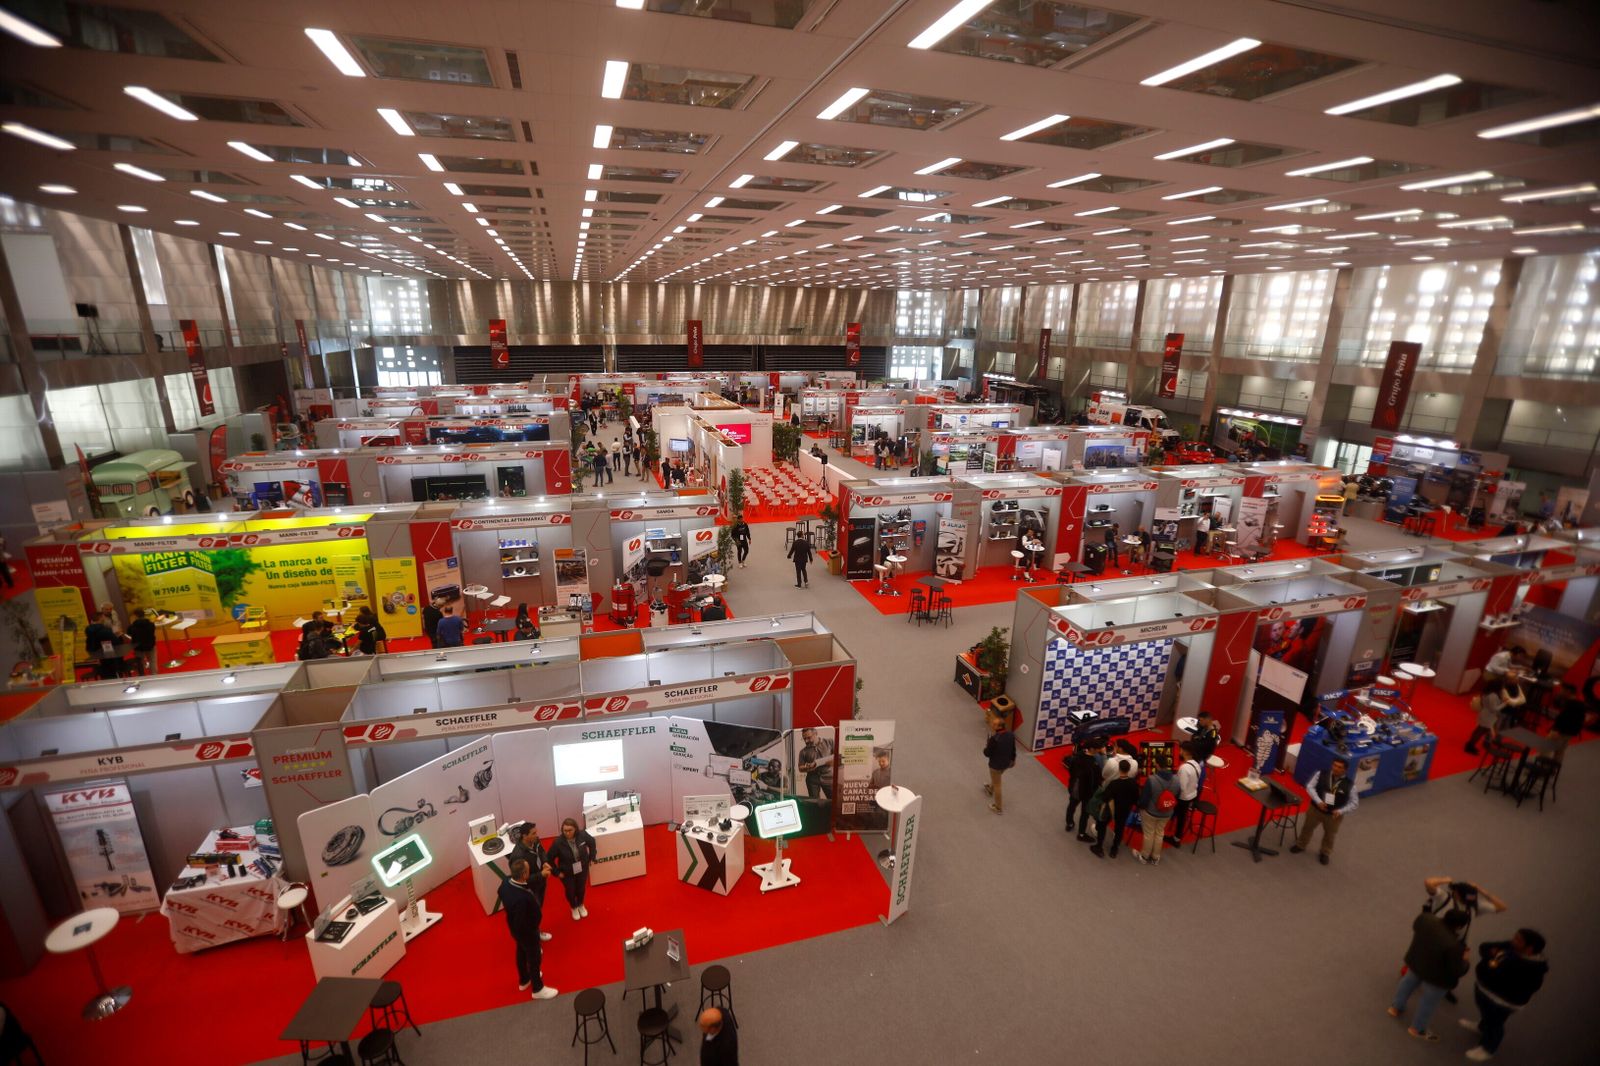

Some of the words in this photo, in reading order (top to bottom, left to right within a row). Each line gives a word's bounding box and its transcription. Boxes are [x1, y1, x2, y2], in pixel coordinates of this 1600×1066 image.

[1394, 353, 1408, 377] Peña
[1388, 379, 1402, 406] Grupo
[279, 530, 319, 538] MANN-FILTER
[36, 556, 75, 565] PREMIUM
[145, 556, 188, 573] FILTER
[263, 559, 276, 568] La
[279, 558, 312, 567] marca
[315, 556, 328, 565] de
[265, 571, 280, 580] Un
[282, 568, 317, 579] diseño
[320, 567, 333, 576] de
[162, 584, 191, 595] 719/45
[1140, 625, 1168, 633] MICHELIN
[664, 684, 718, 698] SCHAEFFLER
[435, 712, 498, 727] SCHAEFFLER
[581, 725, 656, 740] SCHAEFFLER
[97, 755, 124, 766] KYB
[271, 750, 333, 765] PREMIUM
[442, 744, 488, 772] SCHAEFFLER
[271, 768, 342, 785] SCHAEFFLER
[61, 787, 116, 804] KYB
[593, 850, 641, 865] SCHAEFFLER
[896, 814, 916, 906] SCHAEFFLER
[166, 900, 199, 914] KYB
[206, 893, 240, 908] KYB
[183, 926, 217, 940] KYB
[224, 919, 256, 934] KYB
[351, 930, 398, 976] SCHAEFFLER
